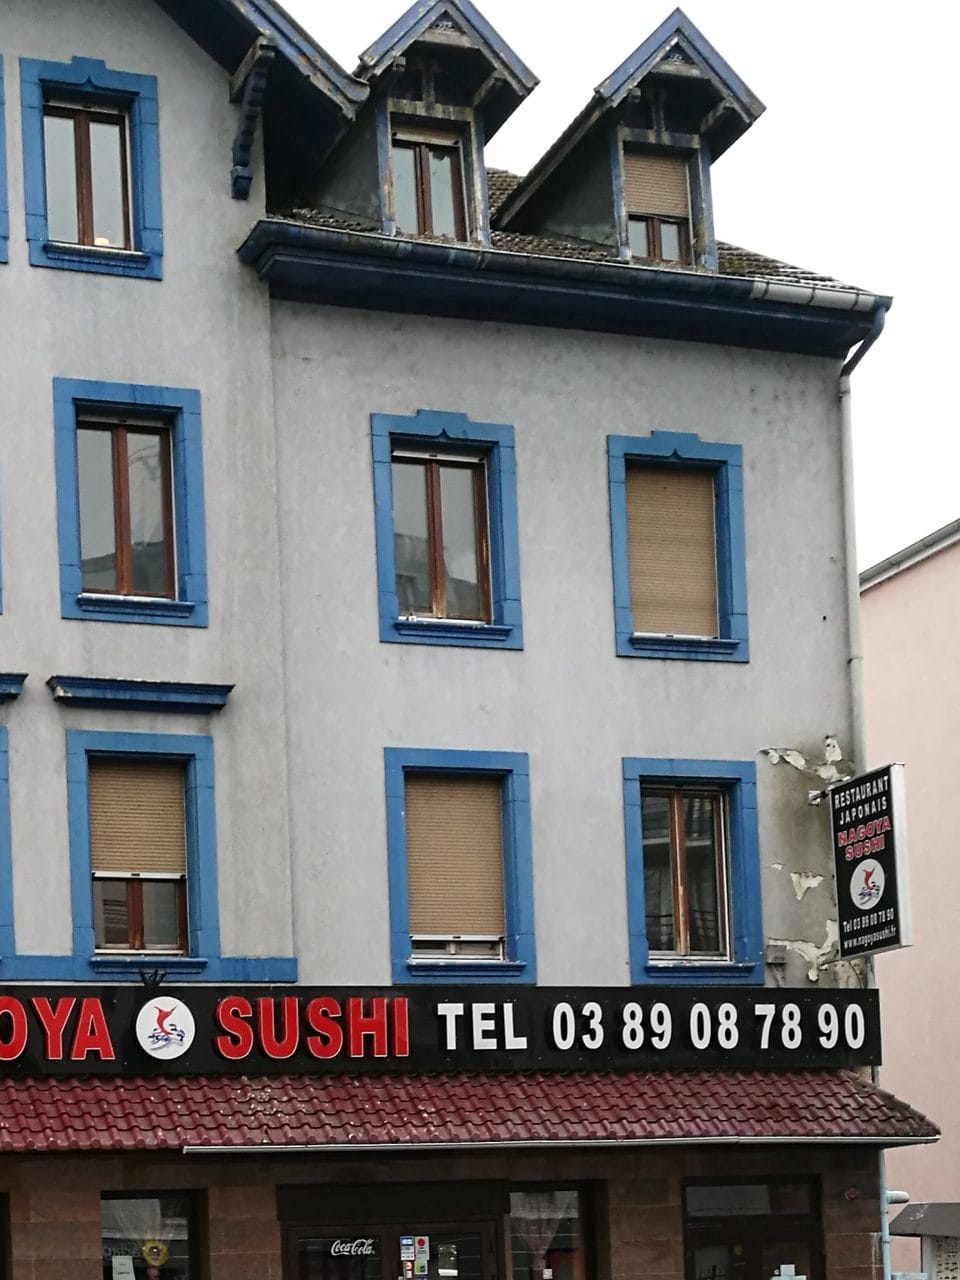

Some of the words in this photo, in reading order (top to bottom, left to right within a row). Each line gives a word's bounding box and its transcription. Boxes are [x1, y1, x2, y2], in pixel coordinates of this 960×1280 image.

[835, 776, 889, 808] RESTAURANT
[840, 796, 887, 825] JAPONAIS
[838, 816, 891, 847] NAGOYA
[845, 834, 885, 860] SUSHI
[853, 917, 860, 930] 03
[216, 996, 410, 1060] SUSHI
[437, 1002, 528, 1051] TEL
[552, 1001, 605, 1050] 03
[622, 1002, 672, 1050] 89
[690, 1003, 739, 1050] 08
[754, 1003, 803, 1050] 78
[817, 1003, 866, 1050] 90
